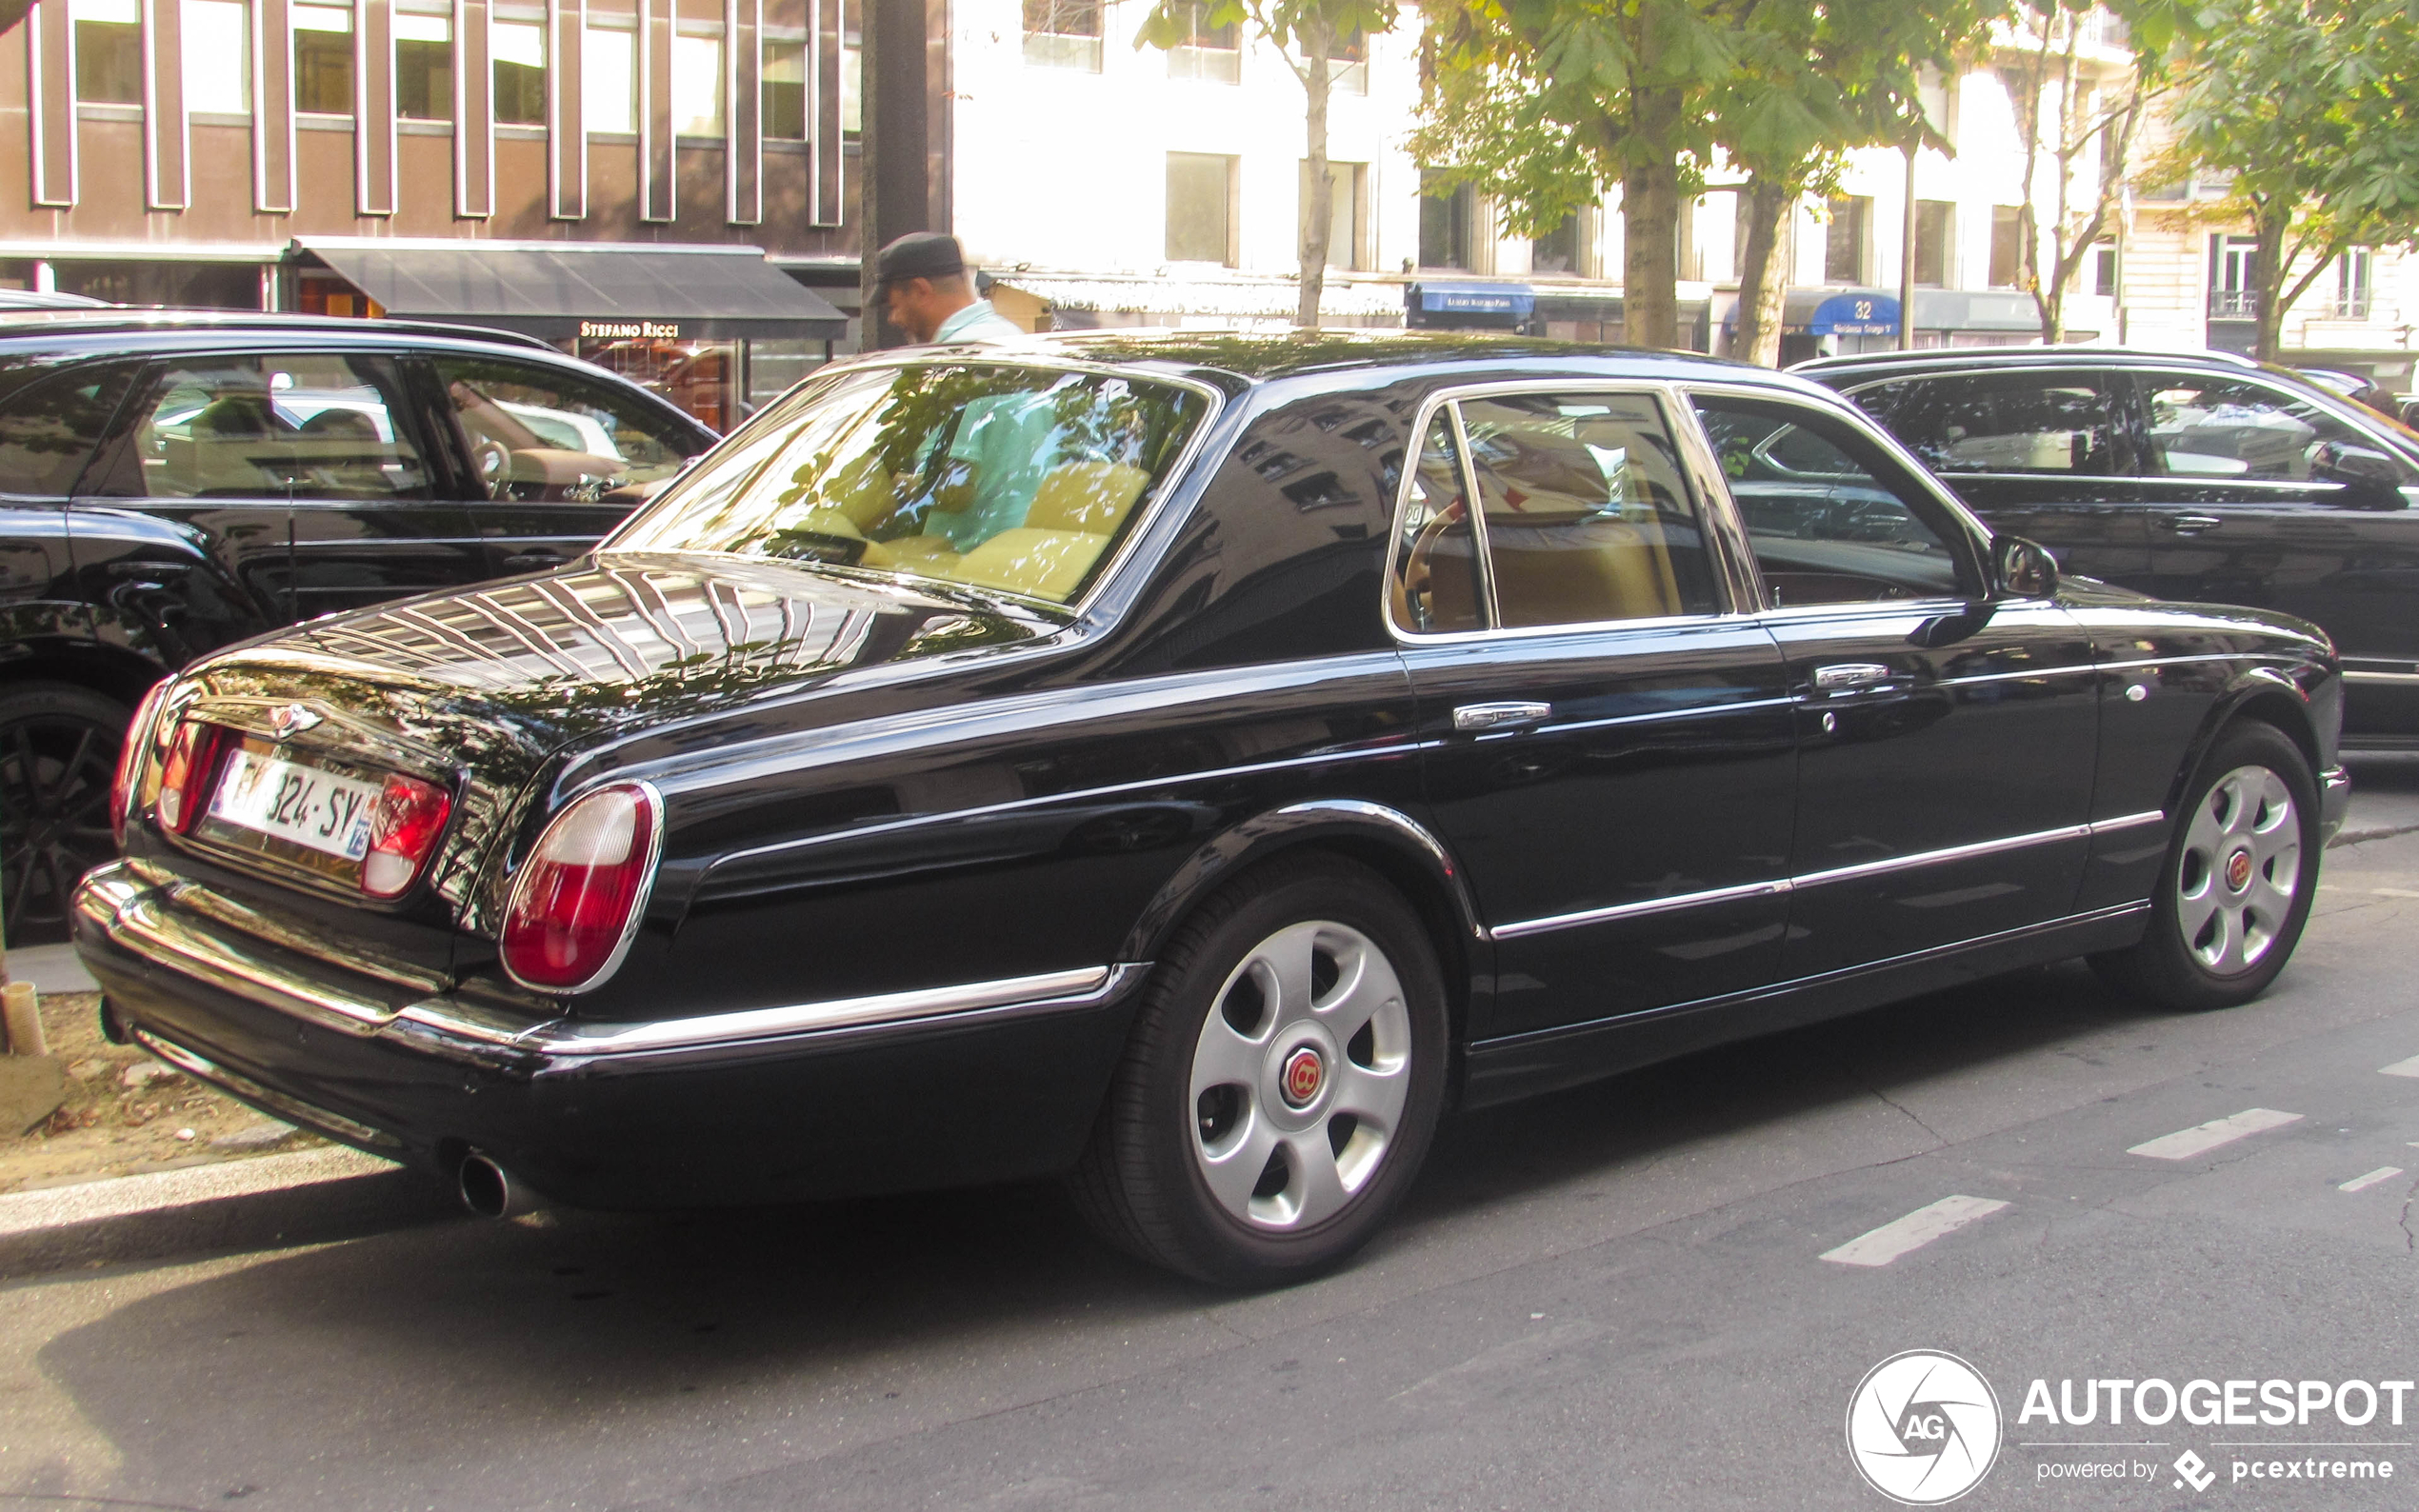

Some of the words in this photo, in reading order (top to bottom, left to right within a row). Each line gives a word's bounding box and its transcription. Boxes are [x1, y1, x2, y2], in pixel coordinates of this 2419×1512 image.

[1854, 301, 1872, 320] 32
[580, 321, 642, 338] STEFANO
[643, 321, 679, 338] RICCI
